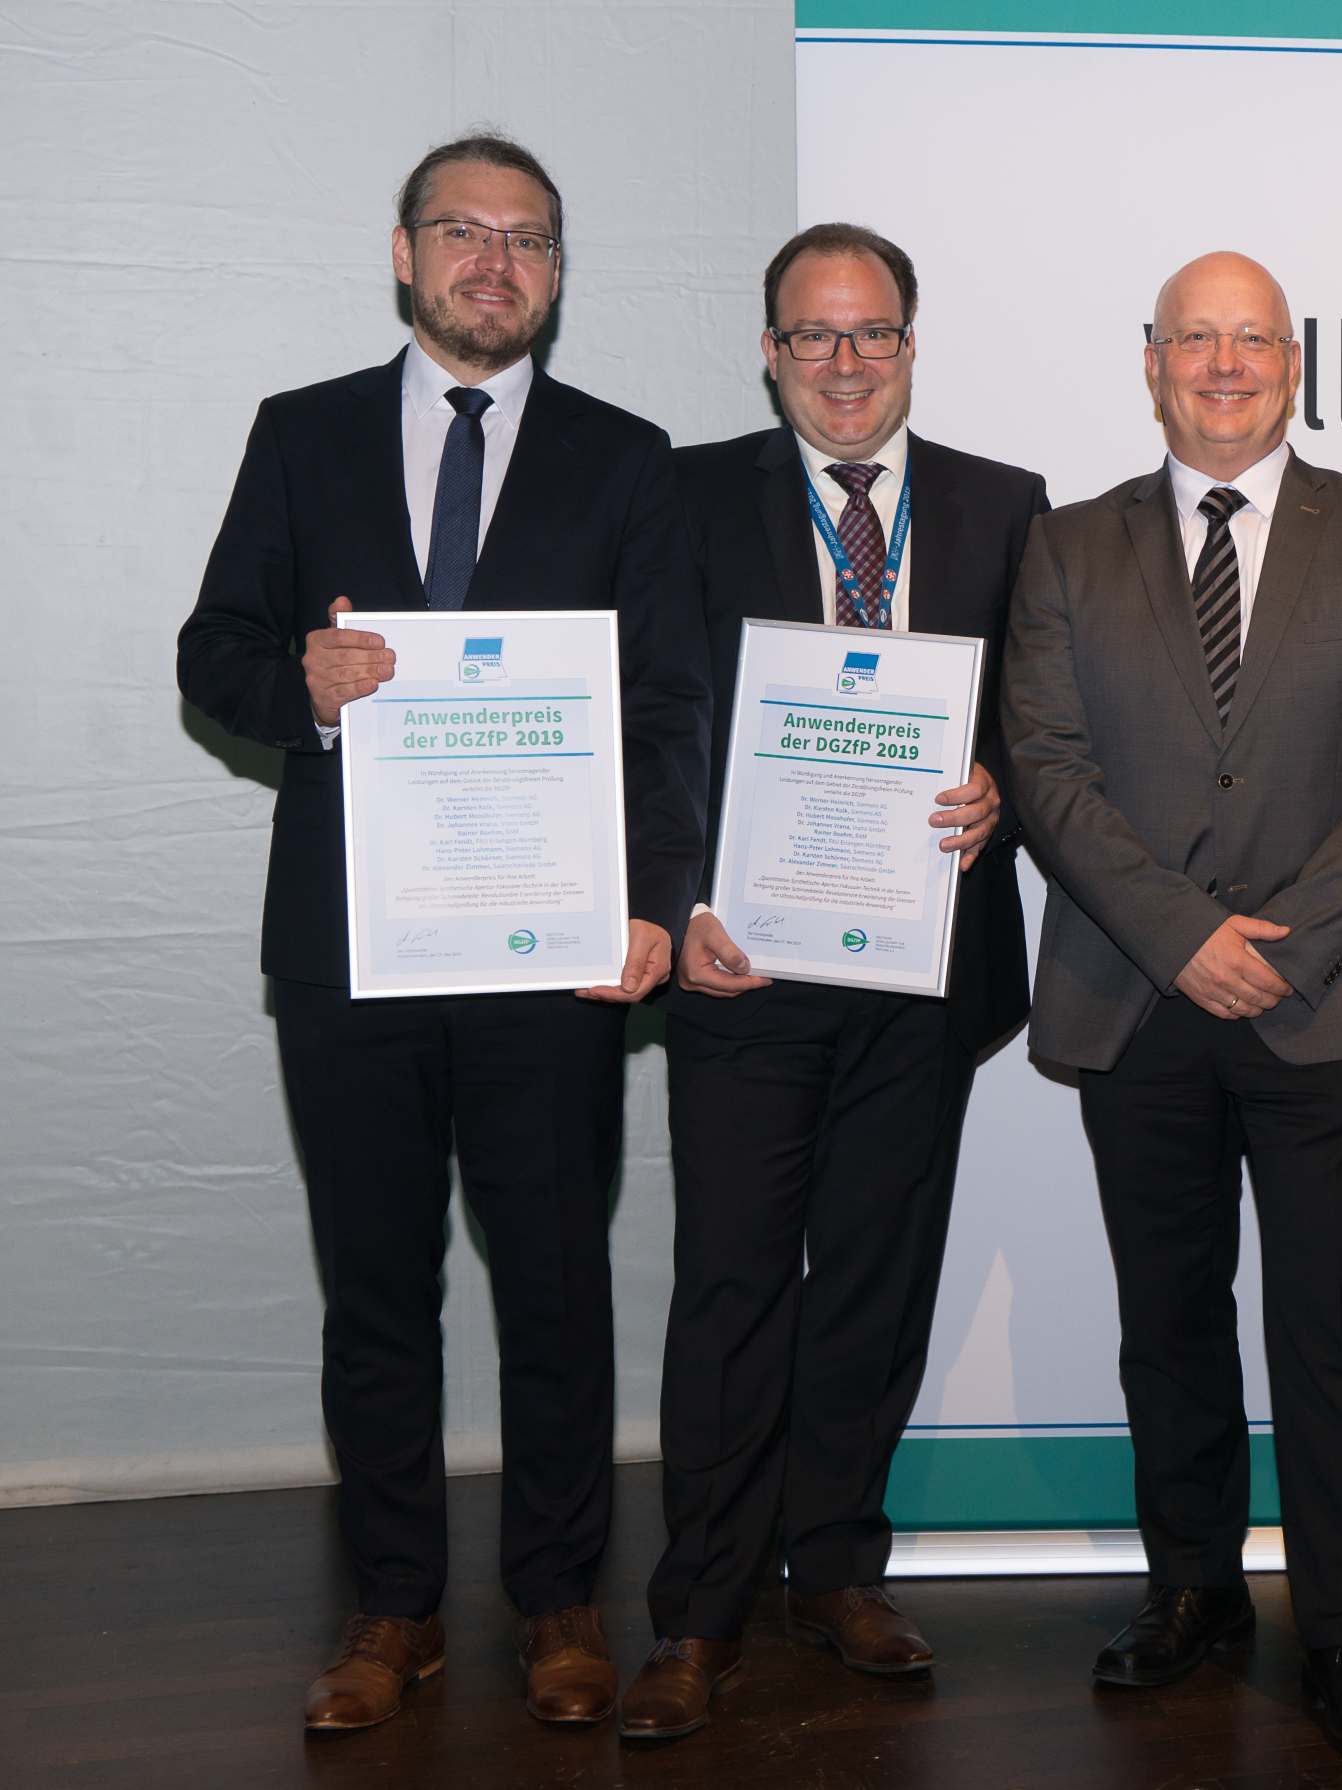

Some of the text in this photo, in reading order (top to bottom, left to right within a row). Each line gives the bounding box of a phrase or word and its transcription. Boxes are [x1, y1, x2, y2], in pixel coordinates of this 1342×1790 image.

[403, 706, 563, 727] Anwenderpreis
[783, 712, 921, 739] Anwenderpreis
[403, 729, 564, 749] der DGZfP 2019
[780, 733, 919, 760] der DGZfP 2019
